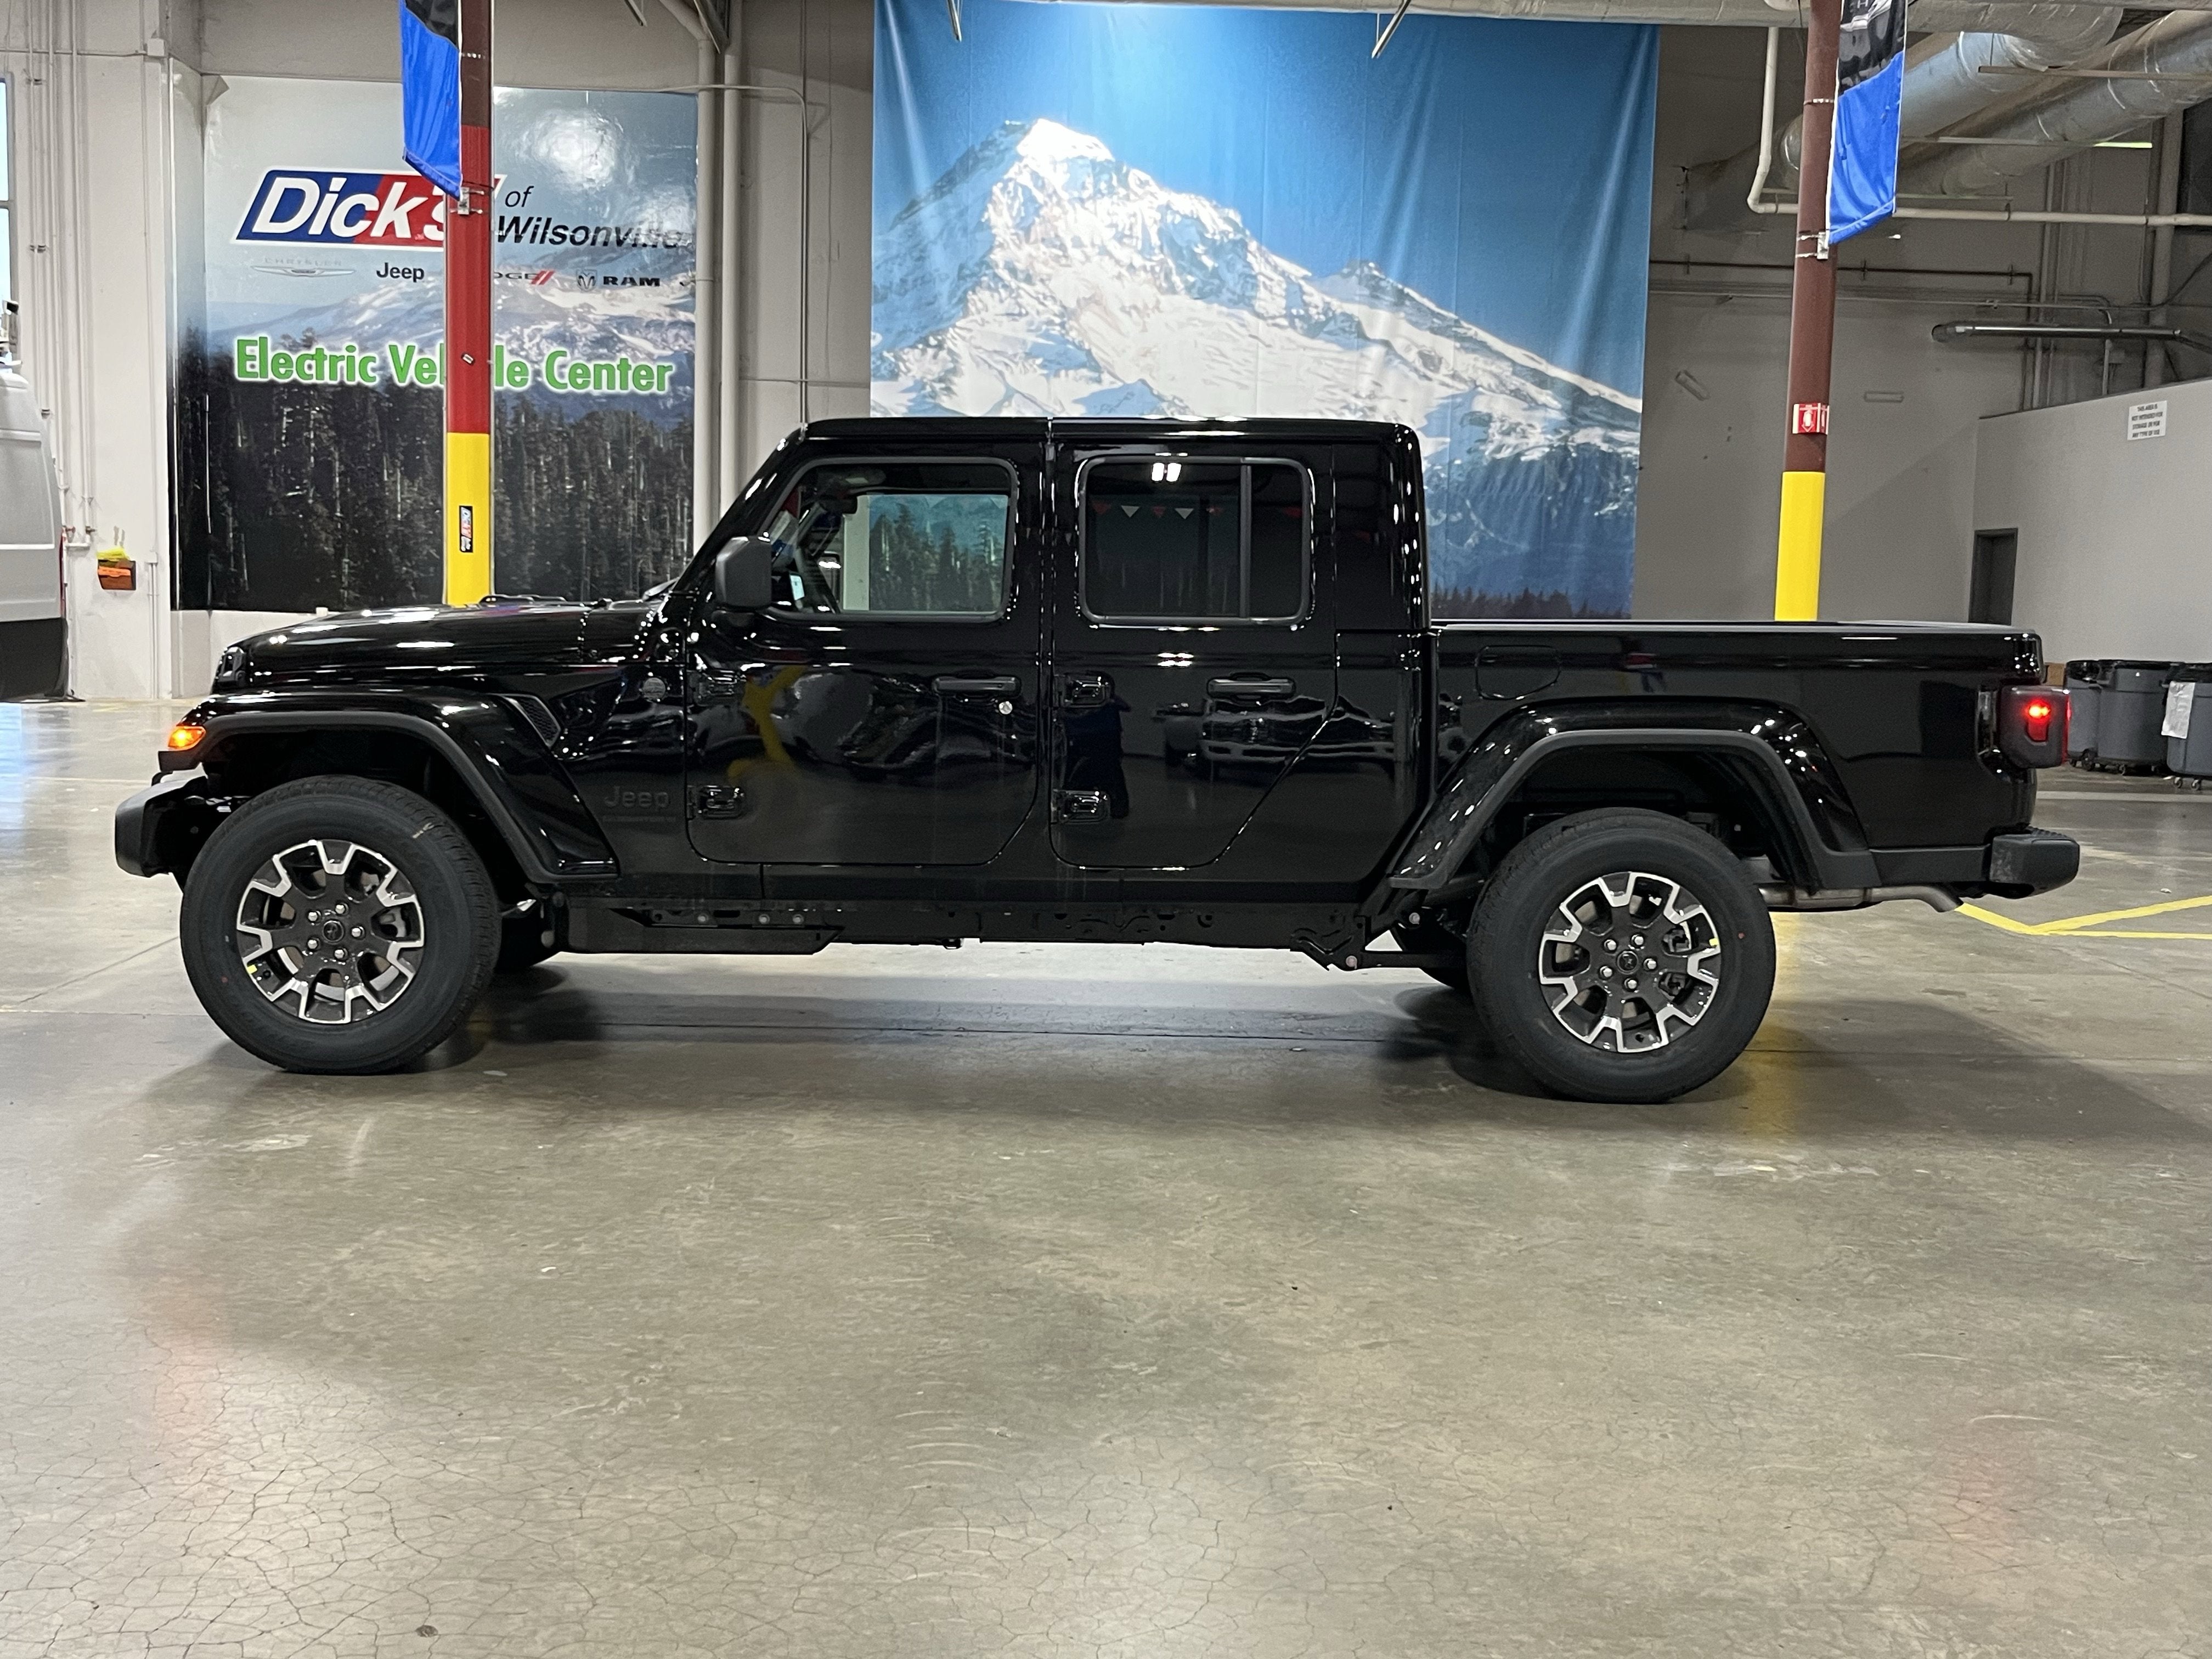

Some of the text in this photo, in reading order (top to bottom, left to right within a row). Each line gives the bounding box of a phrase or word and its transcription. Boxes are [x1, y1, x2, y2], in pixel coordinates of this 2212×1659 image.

[505, 185, 534, 208] of
[376, 262, 425, 283] Jeep
[603, 276, 660, 286] RAM
[237, 336, 377, 383] Electric
[545, 350, 673, 392] Center
[604, 786, 669, 812] Jeep
